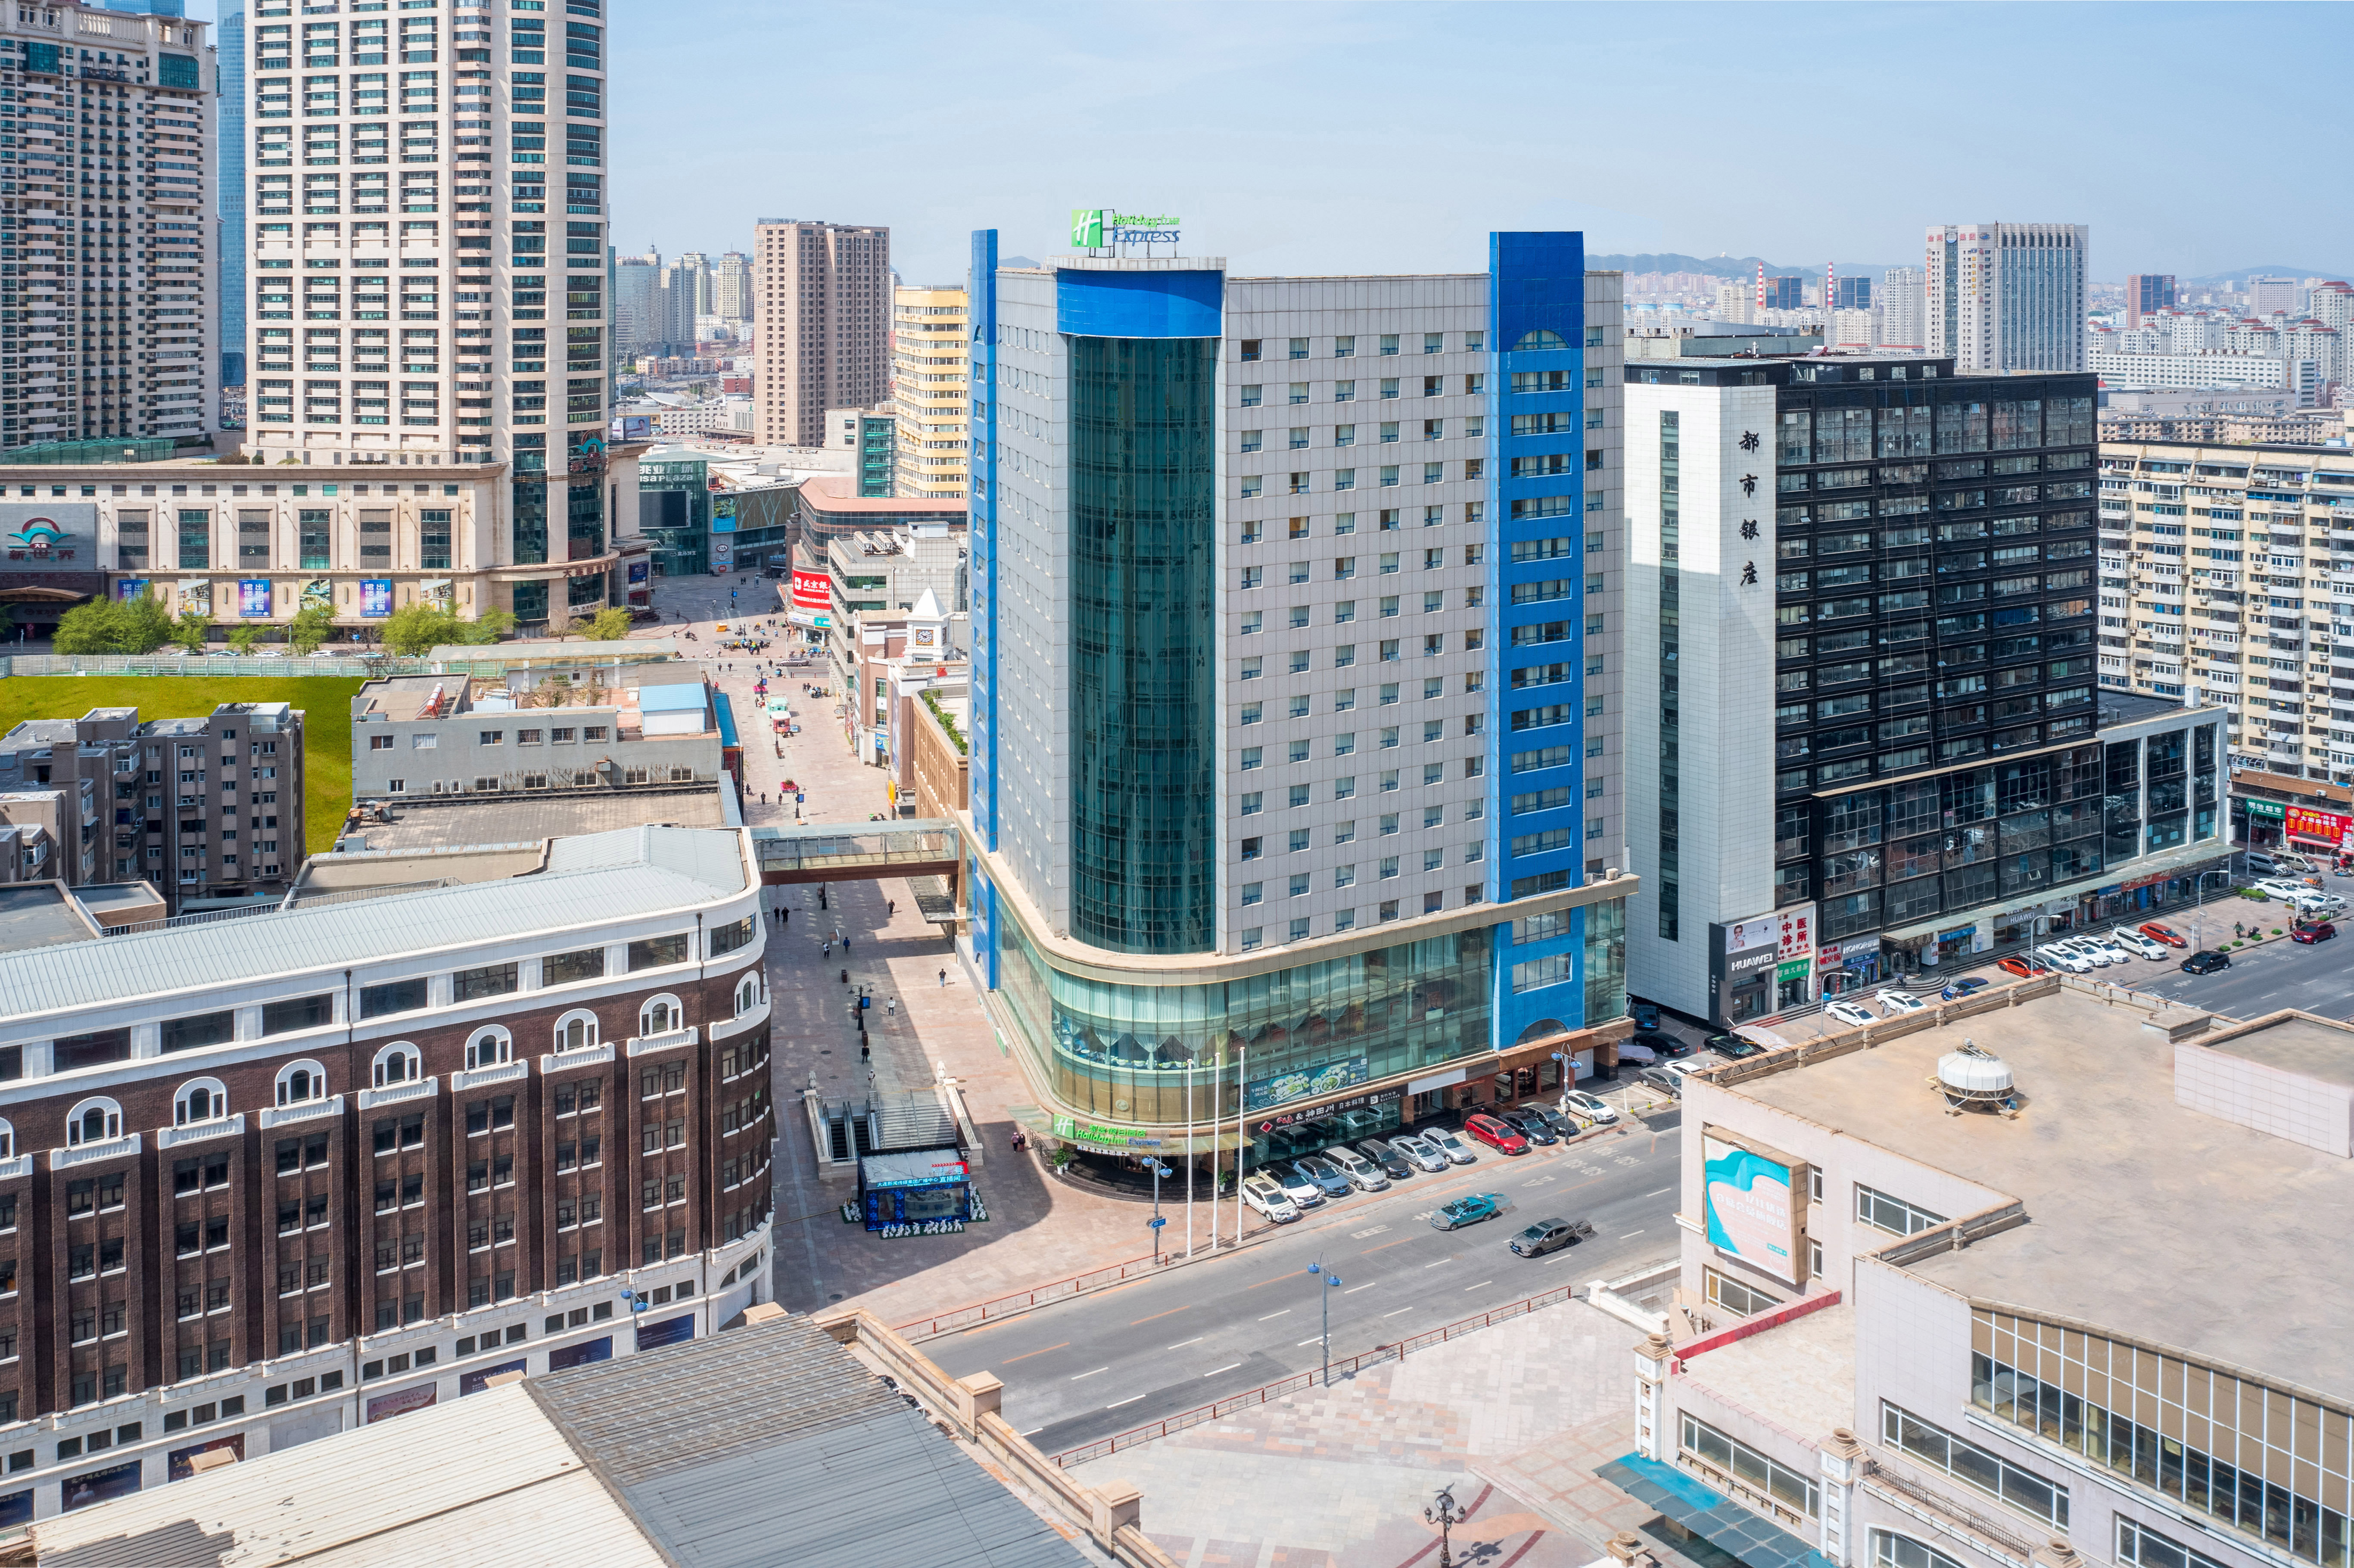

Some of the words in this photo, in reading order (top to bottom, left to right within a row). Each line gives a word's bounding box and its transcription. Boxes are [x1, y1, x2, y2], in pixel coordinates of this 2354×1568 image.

[1112, 213, 1158, 228] Holiday
[1160, 214, 1180, 225] Inn
[1112, 227, 1181, 246] Express
[639, 464, 693, 474] 兆业广场
[1738, 430, 1759, 587] 都市银座
[9, 550, 75, 560] 新世界
[255, 583, 265, 611] 出租出售
[376, 583, 386, 611] 出租出售
[1782, 917, 1807, 933] 中医
[2010, 912, 2035, 924] HUAWEI
[1781, 930, 1807, 946] 诊所
[1843, 942, 1868, 954] HONOR
[1731, 952, 1773, 971] HUAWEI
[1305, 1104, 1334, 1118] 神田川
[1339, 1097, 1364, 1110] 日本料理
[1076, 1129, 1111, 1145] Holiday
[1111, 1135, 1127, 1145] Inn
[1128, 1137, 1161, 1147] Express
[1089, 1123, 1147, 1137] 智选假日酒店
